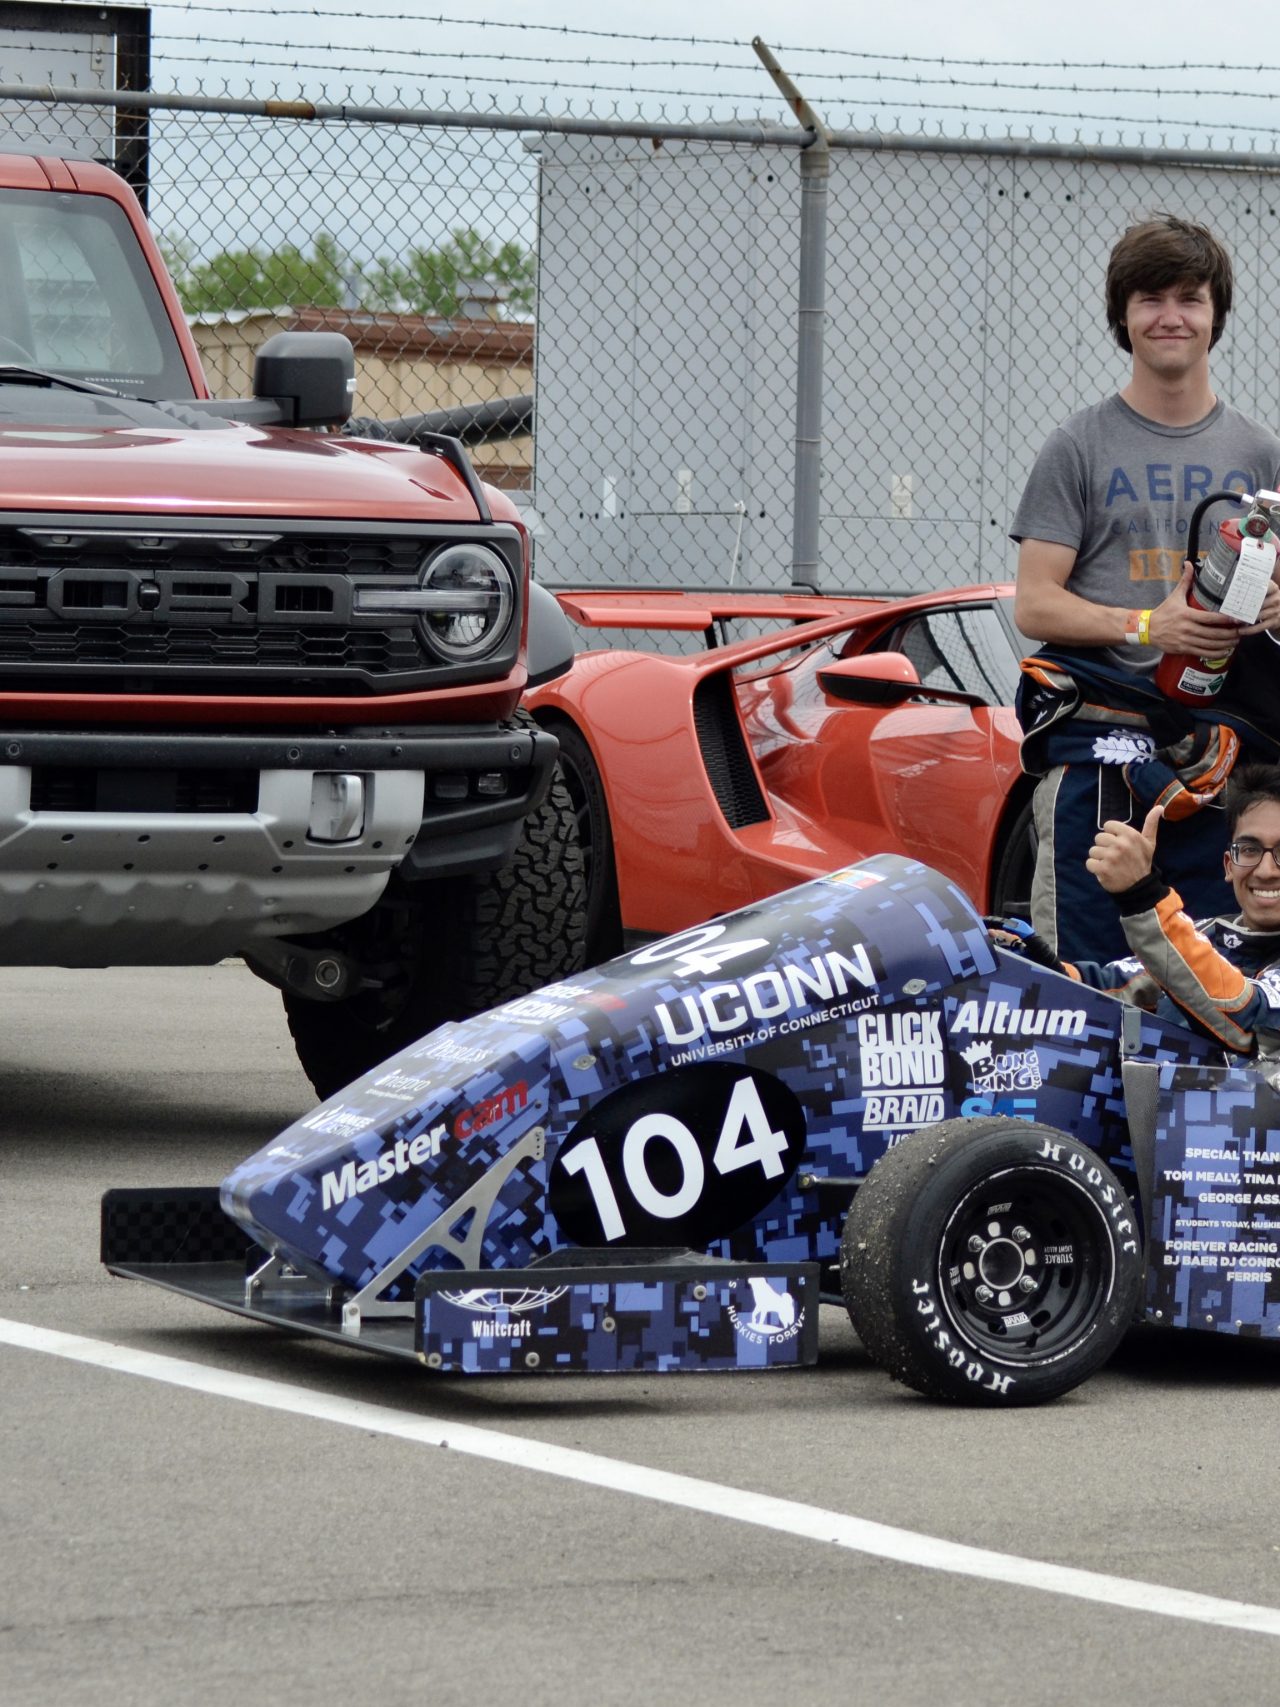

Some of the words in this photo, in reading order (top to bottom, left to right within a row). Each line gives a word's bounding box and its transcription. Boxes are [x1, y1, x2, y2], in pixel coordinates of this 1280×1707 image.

[1105, 463, 1254, 508] AERO
[654, 943, 877, 1045] UCONN
[671, 1033, 755, 1067] UNIVERSITY
[757, 1026, 777, 1042] OF
[779, 994, 880, 1034] CONNECTICUT
[857, 1010, 944, 1050] CLICK
[950, 1000, 1087, 1036] Altium
[860, 1048, 945, 1087] BOND
[971, 1050, 1039, 1079] BUNG
[974, 1067, 1033, 1093] KING
[863, 1095, 945, 1124] BRAID
[560, 1077, 789, 1242] 104
[1185, 1147, 1240, 1161] SPECIAL
[1164, 1170, 1192, 1182] TOM
[1195, 1172, 1241, 1185] MEALY,
[1244, 1174, 1275, 1185] TINA
[1036, 1137, 1137, 1254] Hoosier
[1198, 1192, 1251, 1204] GEORGE
[1175, 1219, 1219, 1227] STUDENTS
[1221, 1220, 1250, 1229] TODAY,
[1164, 1255, 1179, 1266] BJ
[1182, 1256, 1217, 1267] BAER
[1220, 1256, 1236, 1267] DJ
[1165, 1240, 1226, 1252] FOREVER
[1229, 1242, 1277, 1253] RACING
[1226, 1271, 1272, 1283] FERRIS
[471, 1319, 532, 1338] Whitcraft
[727, 1305, 763, 1344] HUSKIES
[769, 1306, 806, 1345] FOREVE
[912, 1278, 1017, 1395] Hoosier
